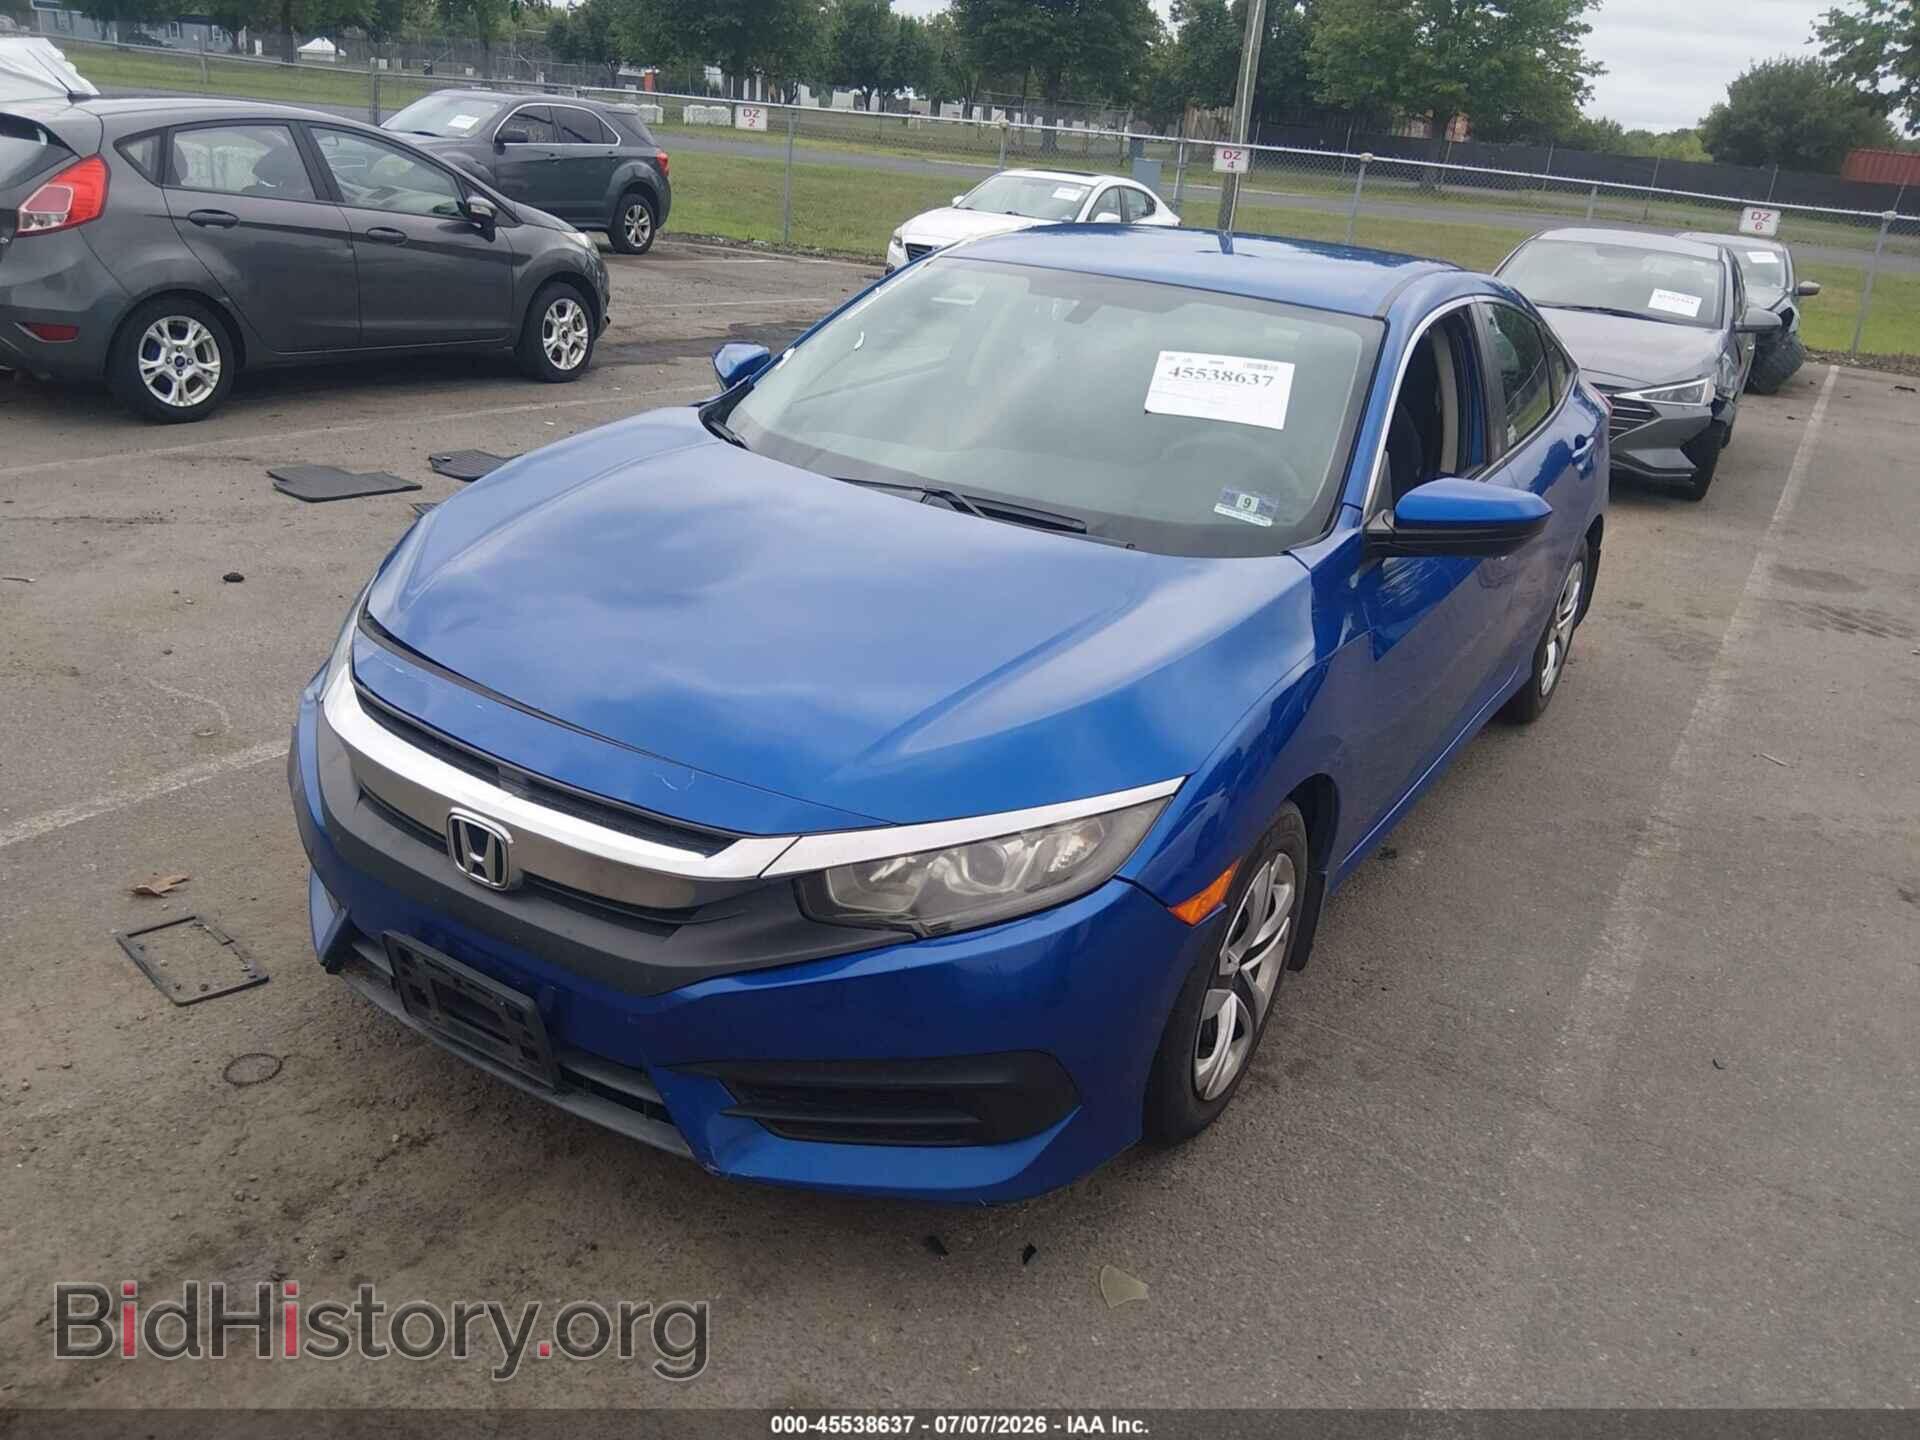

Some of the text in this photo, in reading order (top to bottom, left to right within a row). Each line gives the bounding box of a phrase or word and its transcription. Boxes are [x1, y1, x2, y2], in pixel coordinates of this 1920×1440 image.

[743, 108, 761, 119] DZ
[748, 118, 756, 128] 2
[1223, 150, 1242, 161] DZ
[1226, 160, 1235, 169] 4
[1752, 211, 1770, 223] DZ
[1755, 222, 1763, 231] 6
[1167, 366, 1275, 388] 45538637
[1243, 497, 1252, 509] 9
